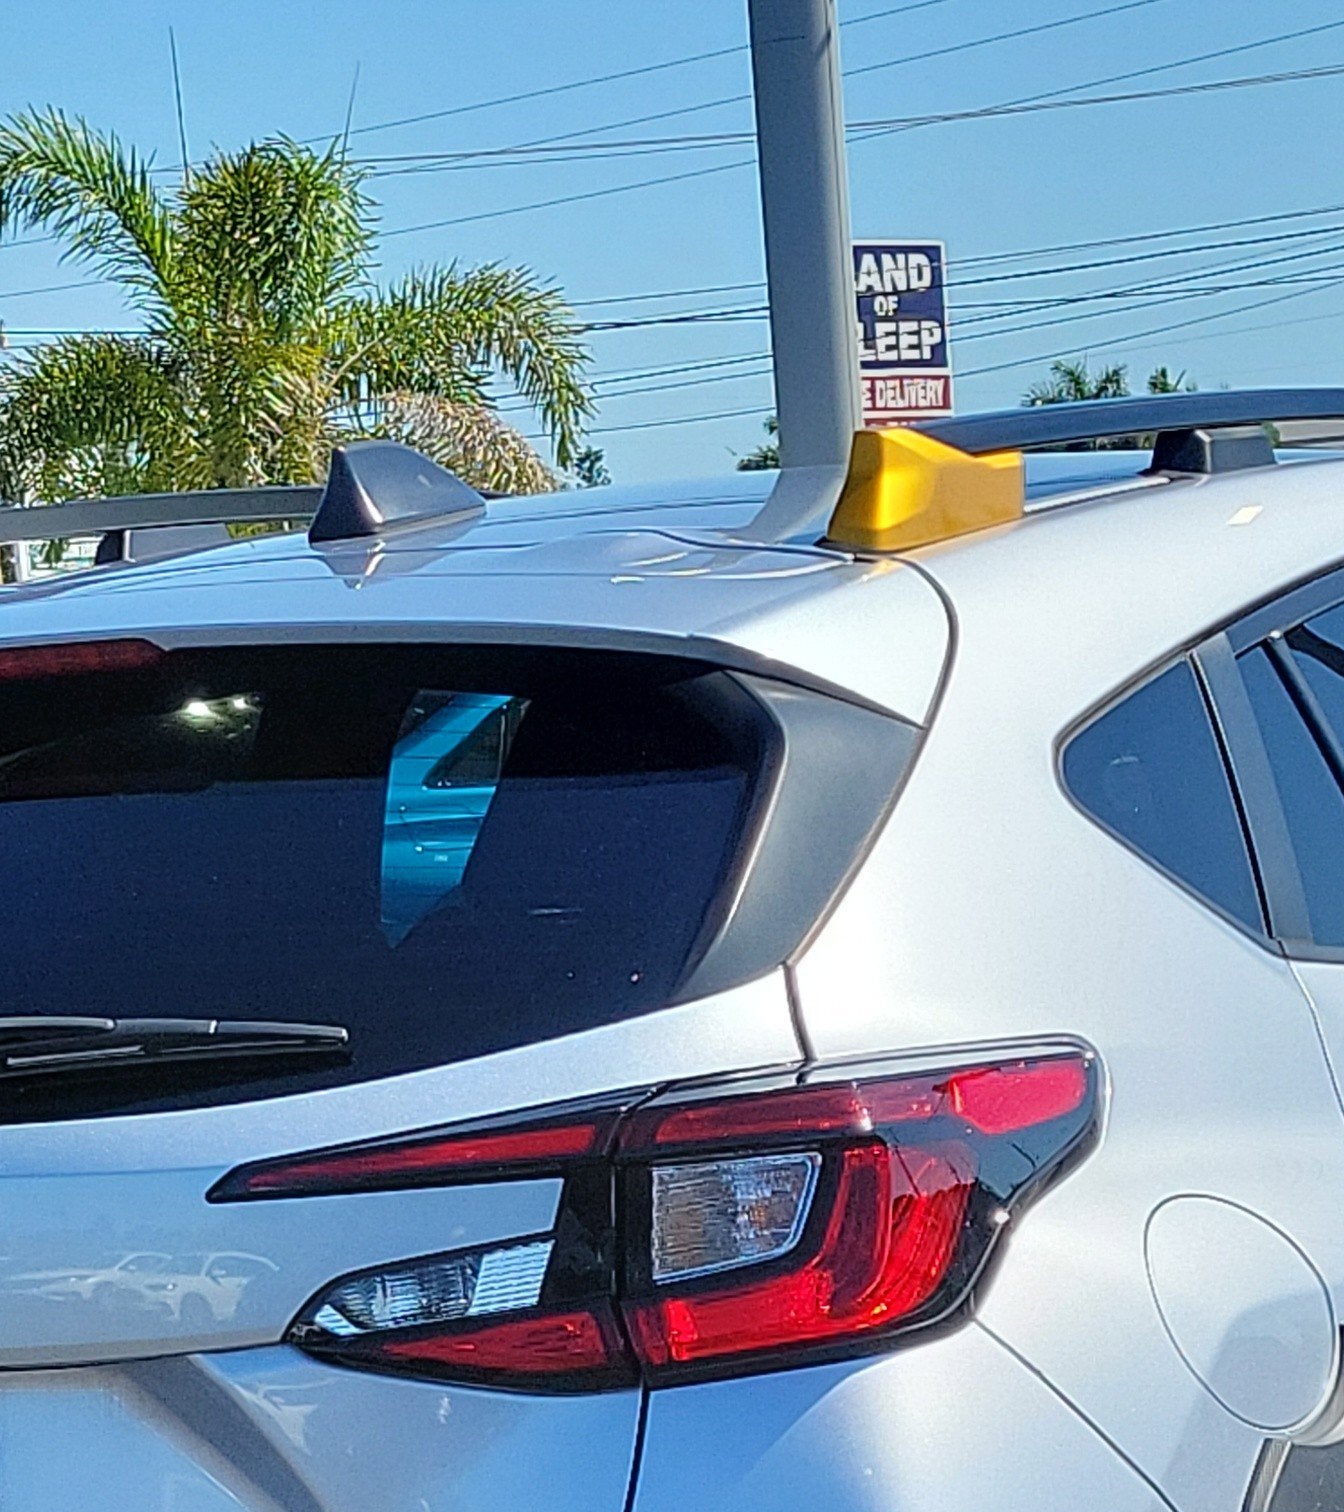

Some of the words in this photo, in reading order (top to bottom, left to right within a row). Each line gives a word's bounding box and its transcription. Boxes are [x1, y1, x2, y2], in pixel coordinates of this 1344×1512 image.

[856, 253, 932, 293] AND
[873, 295, 899, 316] OF
[857, 321, 942, 361] LEEP
[875, 378, 944, 408] DELIVERY
